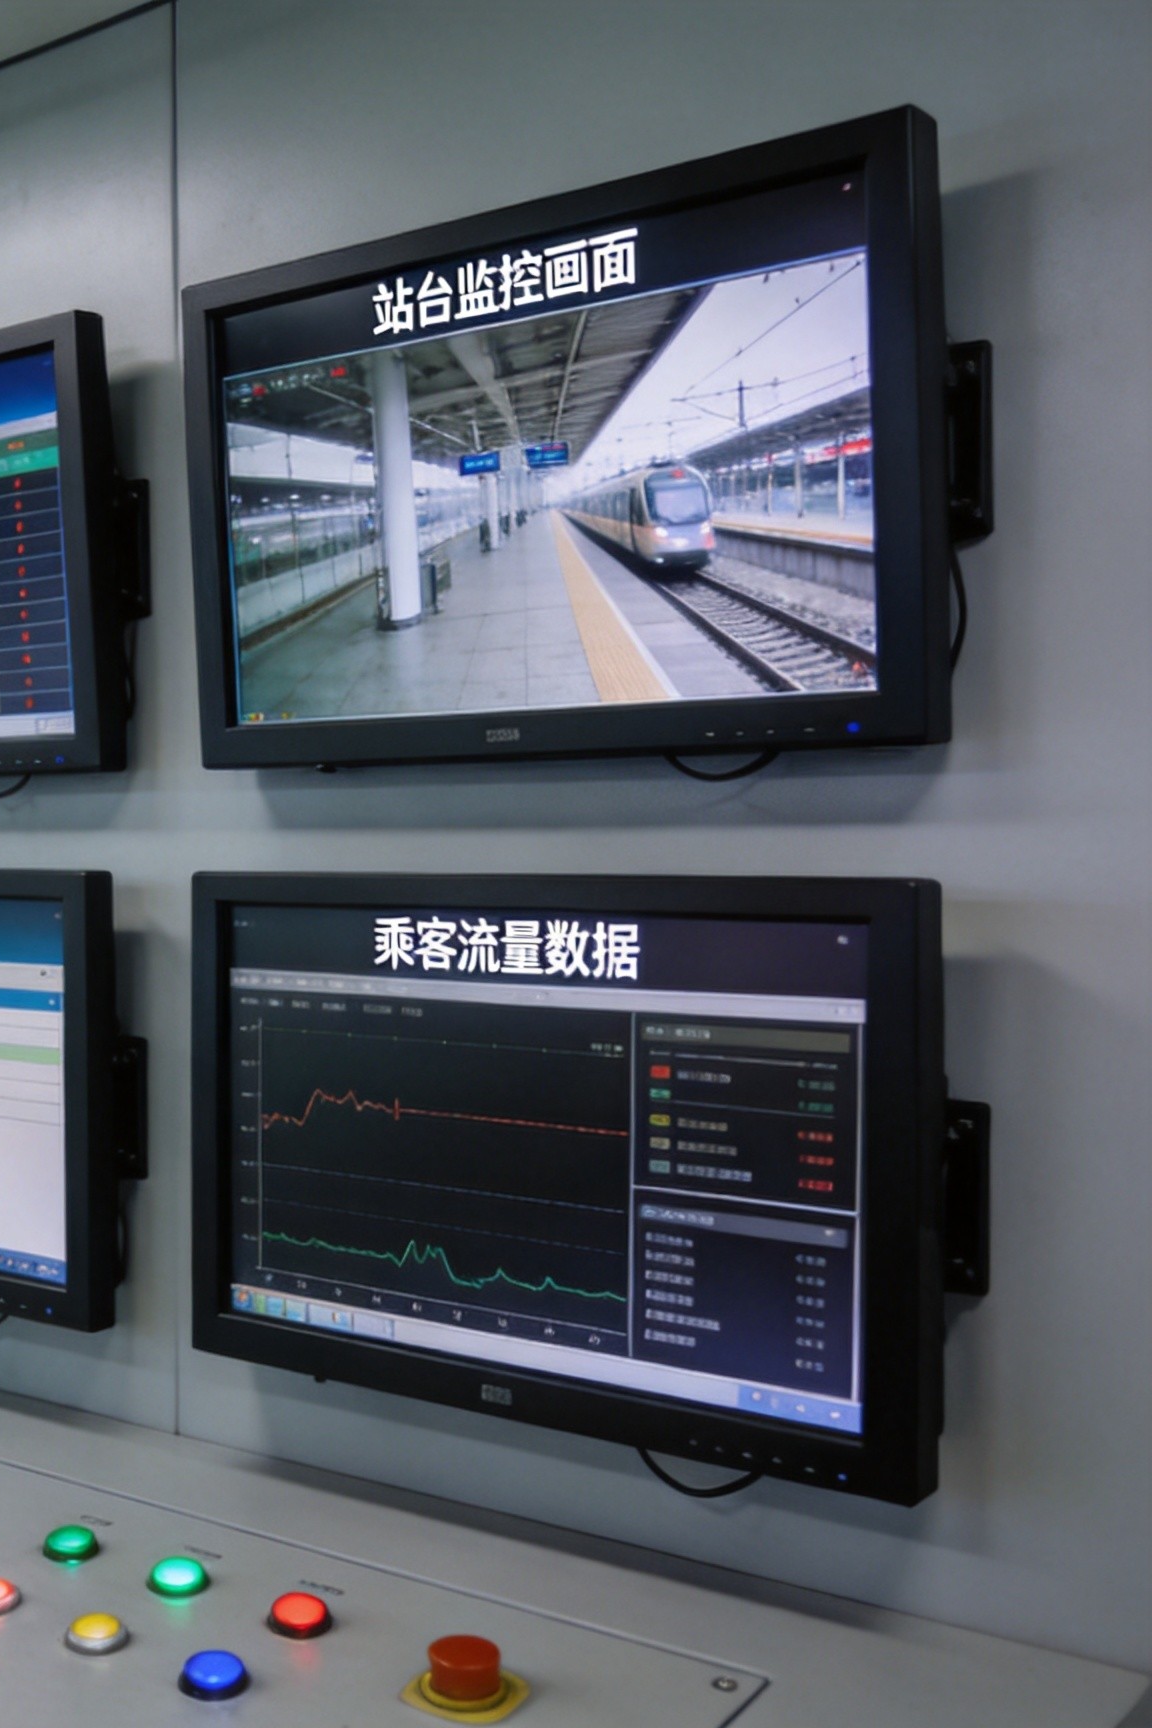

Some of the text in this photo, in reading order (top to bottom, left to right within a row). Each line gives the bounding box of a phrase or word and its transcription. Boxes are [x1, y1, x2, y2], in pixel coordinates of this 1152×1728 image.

[372, 227, 638, 335] 站台监控画面
[374, 916, 640, 980] 乘客流量数据
